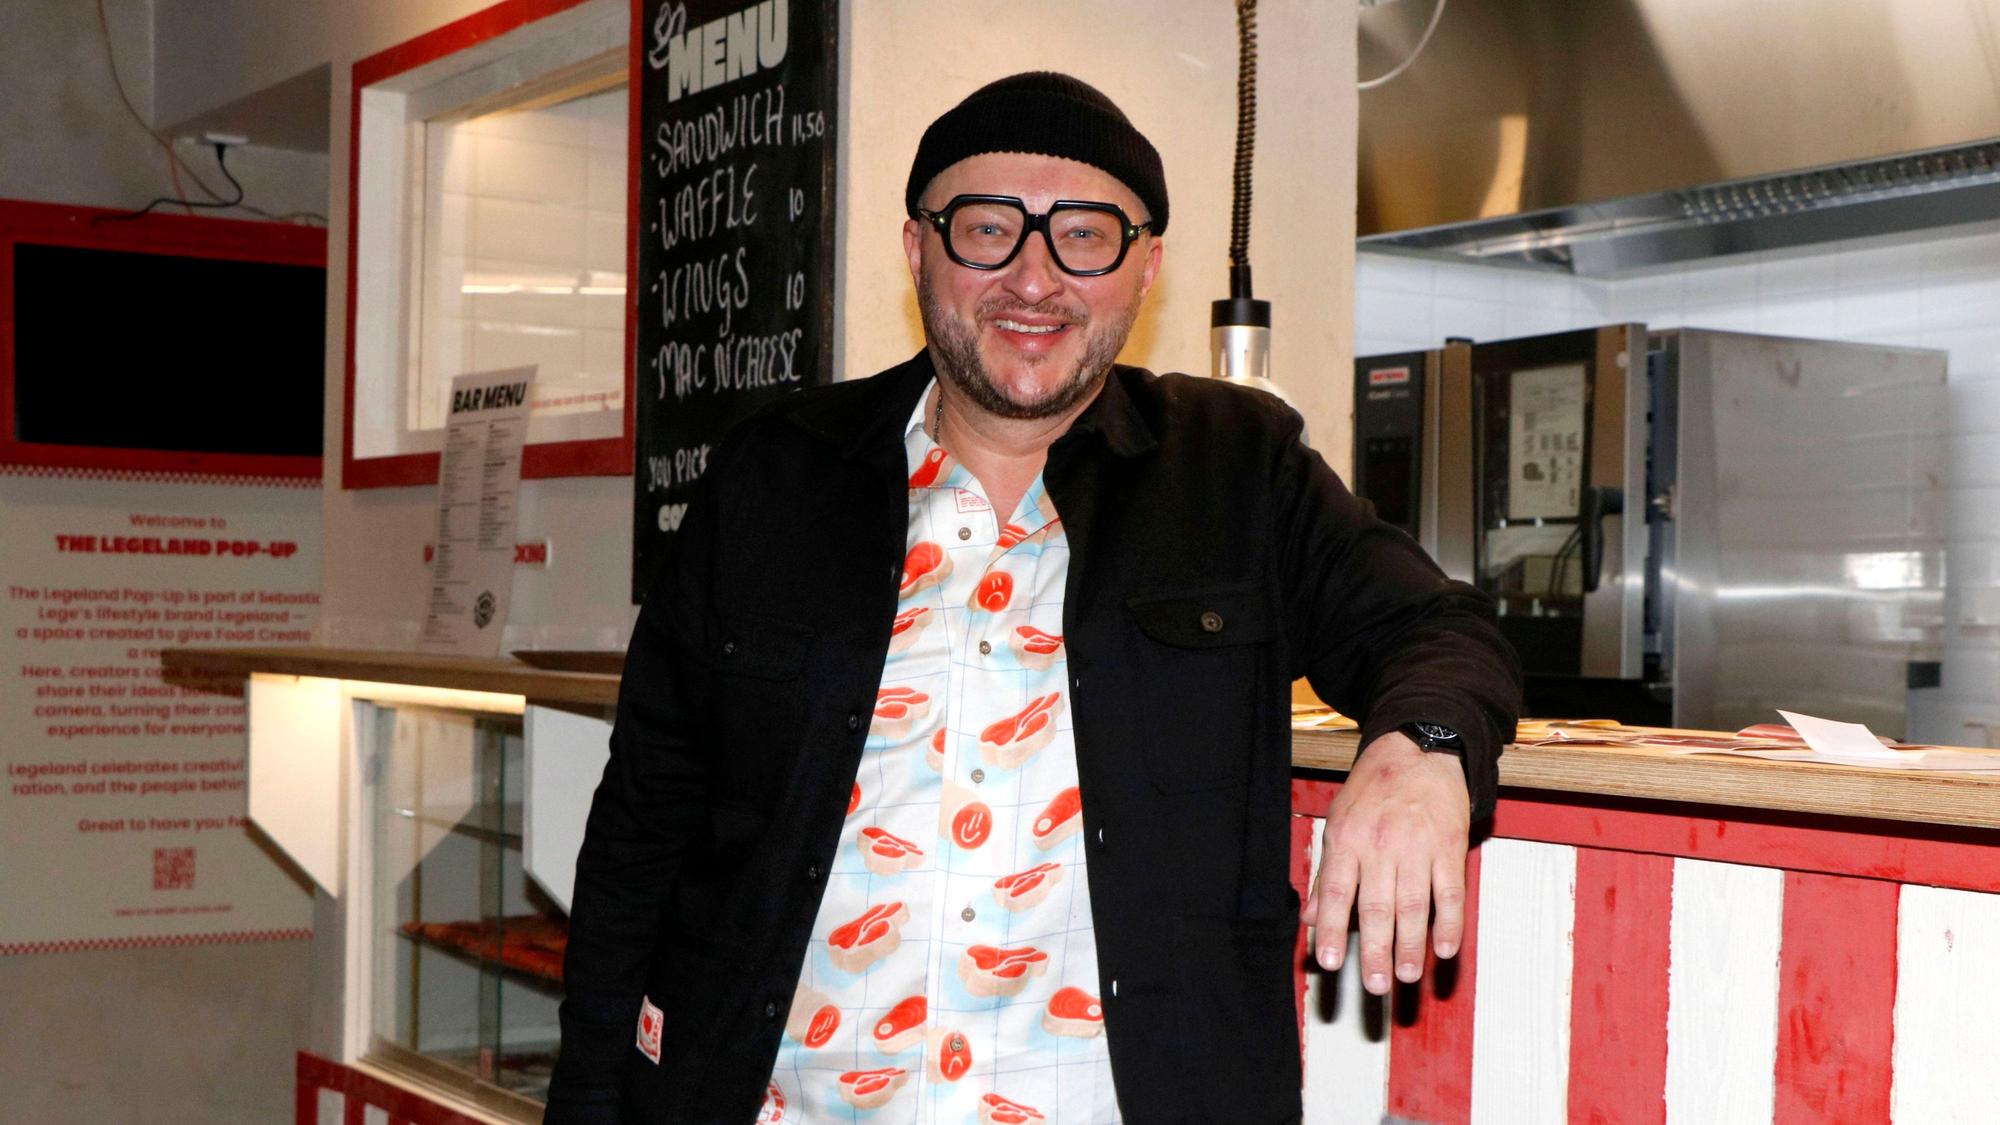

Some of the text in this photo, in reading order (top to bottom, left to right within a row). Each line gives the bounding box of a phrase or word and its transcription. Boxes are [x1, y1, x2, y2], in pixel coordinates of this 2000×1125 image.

[668, 0, 789, 102] MENU
[657, 85, 785, 178] SANDWICH
[659, 162, 804, 250] WAFFLE 10
[659, 247, 804, 337] WINGS 10
[452, 387, 482, 414] BAR
[482, 381, 528, 409] MENU
[129, 514, 226, 529] Welcome to
[56, 535, 297, 558] THE LEGELAND POP-UP
[9, 586, 39, 600] The
[43, 587, 118, 604] Legeland
[123, 588, 184, 604] Pop-Up
[189, 589, 200, 602] is
[205, 589, 237, 605] part
[240, 590, 256, 603] of
[38, 606, 91, 623] Lege's
[97, 606, 160, 624] lifestyle
[165, 607, 213, 622] brand
[217, 608, 289, 626] Legeland
[17, 628, 28, 639] a
[33, 628, 84, 643] space
[89, 625, 154, 640] created
[158, 626, 174, 640] to
[178, 626, 212, 644] give
[216, 626, 255, 641] Food
[127, 648, 138, 659] a
[21, 665, 64, 679] Here,
[69, 665, 140, 678] creators
[36, 684, 84, 697] share
[89, 684, 127, 697] their
[131, 684, 176, 697] ideas
[33, 703, 106, 718] camera,
[109, 703, 170, 720] turning
[174, 703, 211, 717] their
[47, 723, 140, 740] experience
[145, 722, 167, 735] for
[8, 761, 86, 780] Legeland
[91, 760, 178, 776] celebrates
[12, 782, 66, 797] ration,
[73, 780, 105, 795] and
[110, 779, 136, 793] the
[141, 780, 196, 797] people
[78, 818, 124, 833] Great
[129, 819, 145, 832] to
[151, 817, 190, 831] have
[195, 818, 225, 835] you
